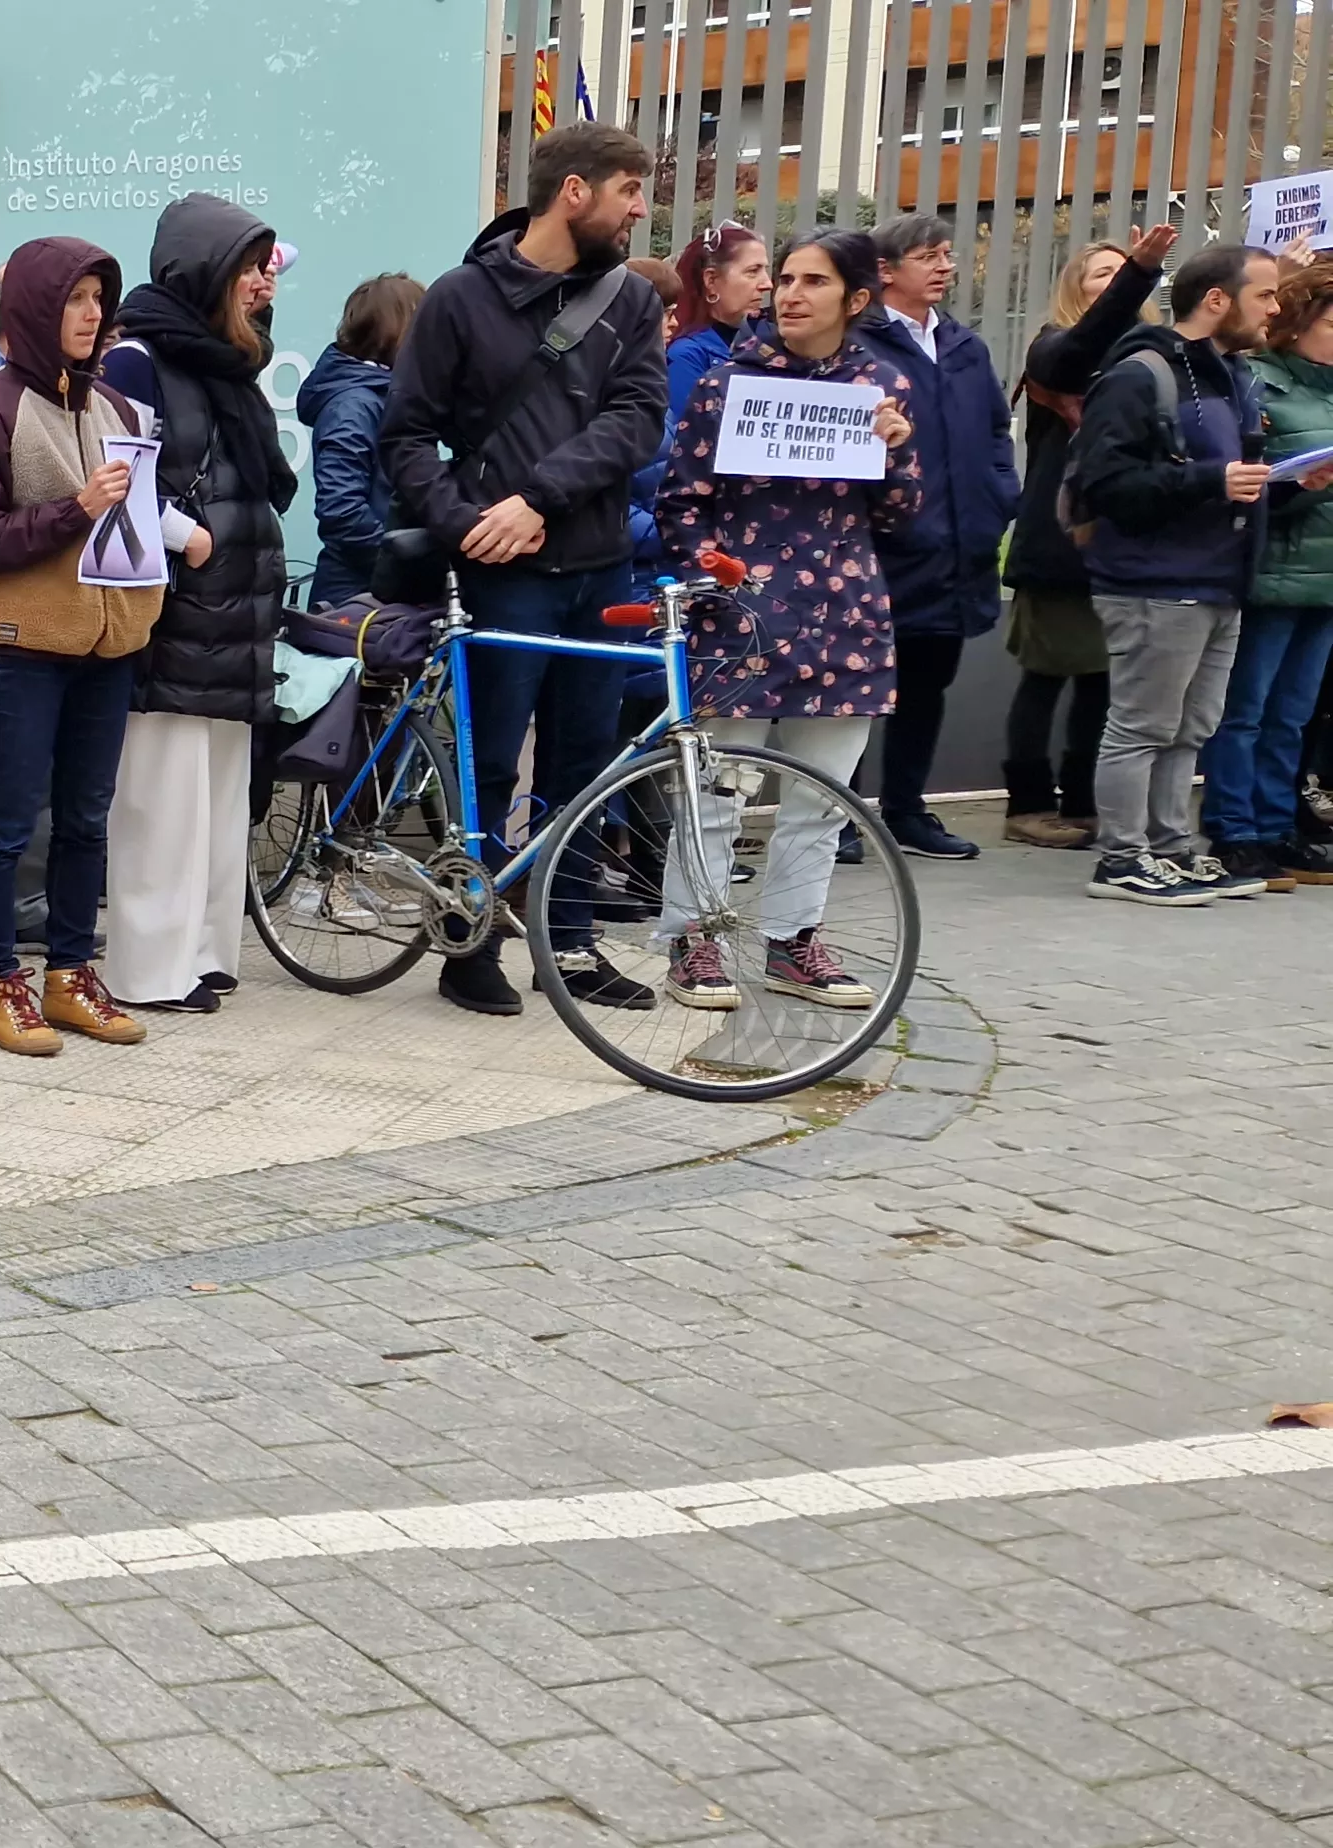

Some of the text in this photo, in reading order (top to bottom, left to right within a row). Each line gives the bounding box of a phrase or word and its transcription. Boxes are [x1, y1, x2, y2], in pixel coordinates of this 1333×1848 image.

[8, 148, 242, 179] Instituto Aragonés
[8, 181, 269, 211] de Servicios Siales
[1276, 184, 1321, 206] EXIGIMOS
[1263, 229, 1272, 245] Y
[742, 399, 874, 427] QUE LA VOCACIÓN
[735, 419, 872, 445] NO SE ROMPA POR
[766, 443, 835, 462] EL MIEDO
